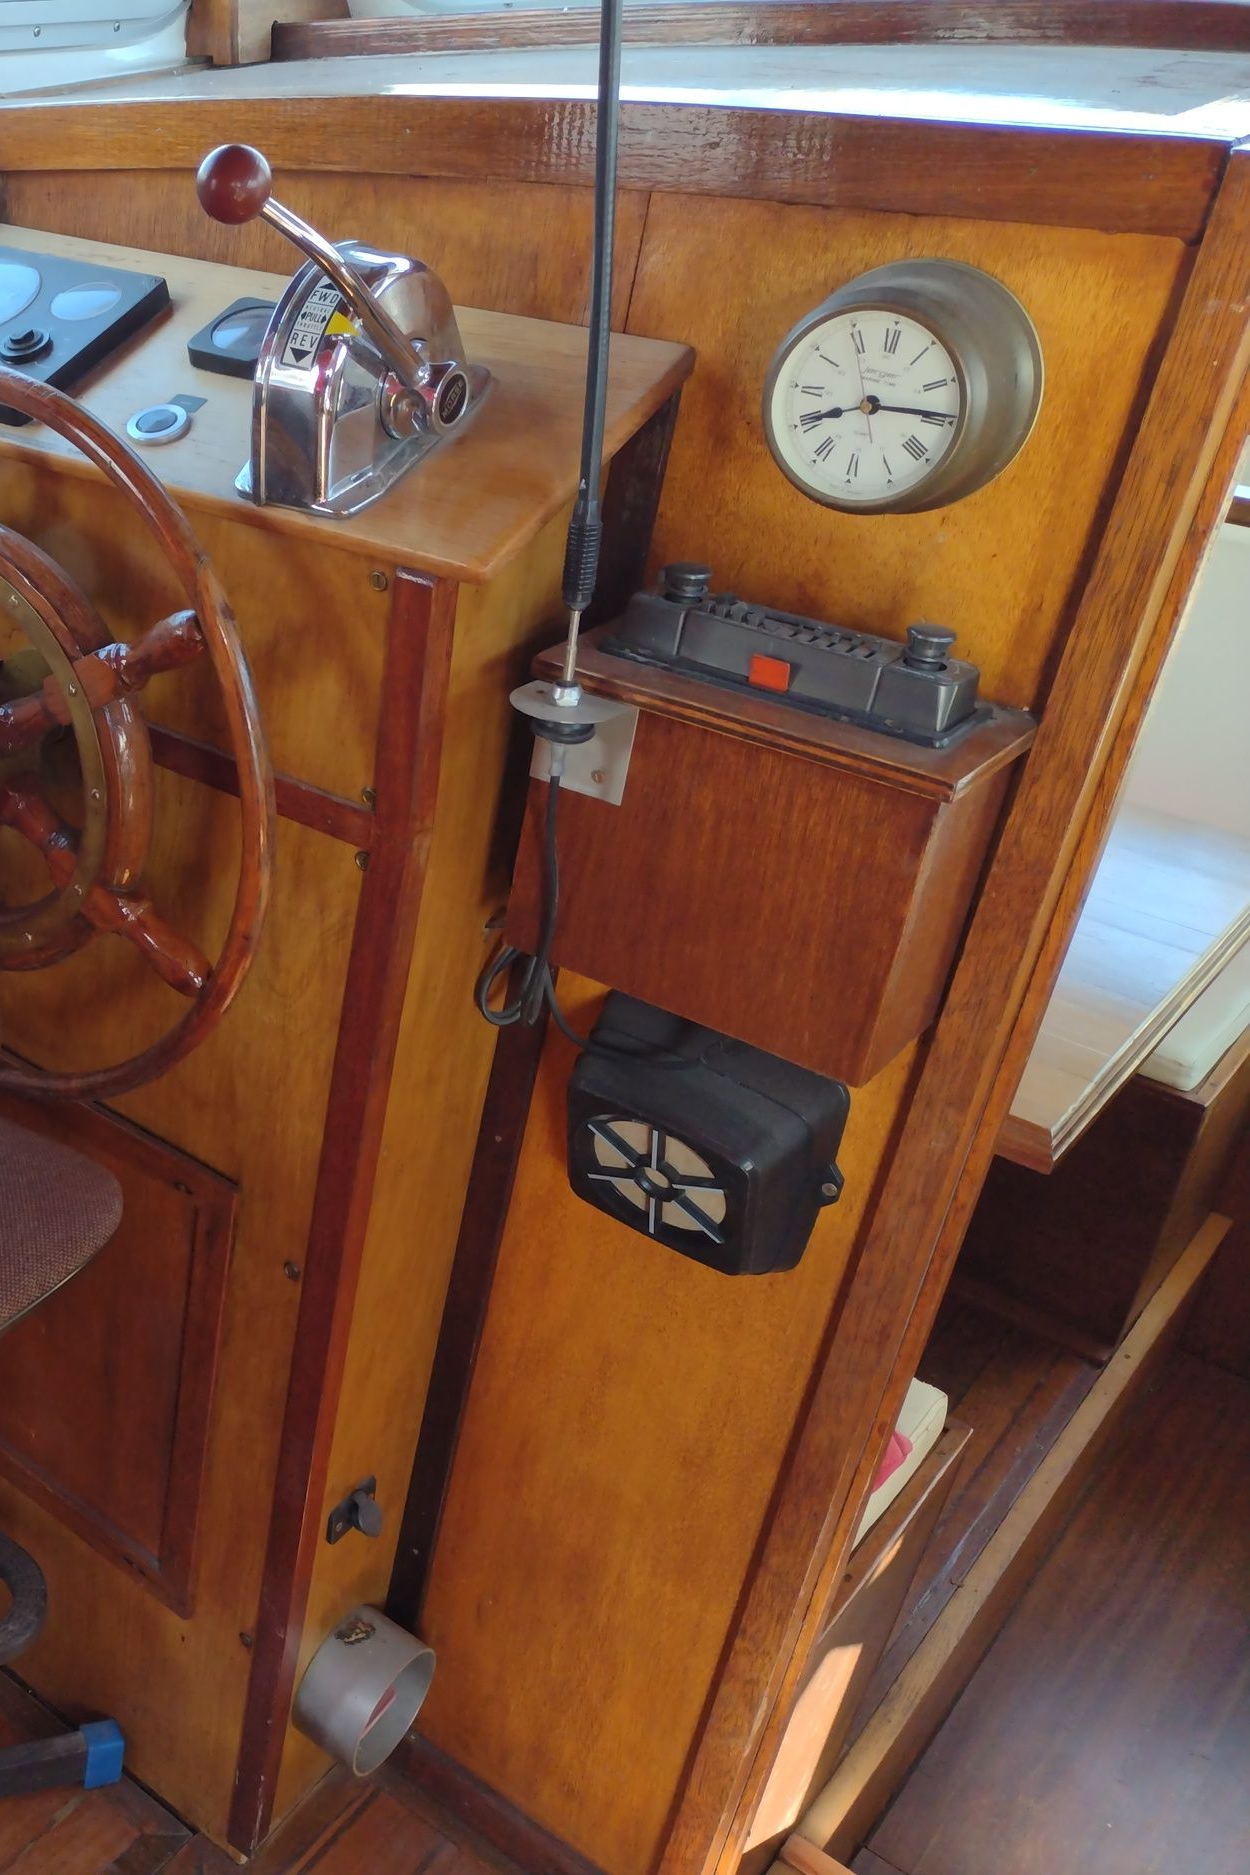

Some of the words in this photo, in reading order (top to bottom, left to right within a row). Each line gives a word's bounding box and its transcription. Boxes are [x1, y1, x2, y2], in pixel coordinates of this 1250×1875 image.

[310, 290, 339, 303] FWD
[305, 312, 322, 323] PULL
[290, 333, 318, 348] REV
